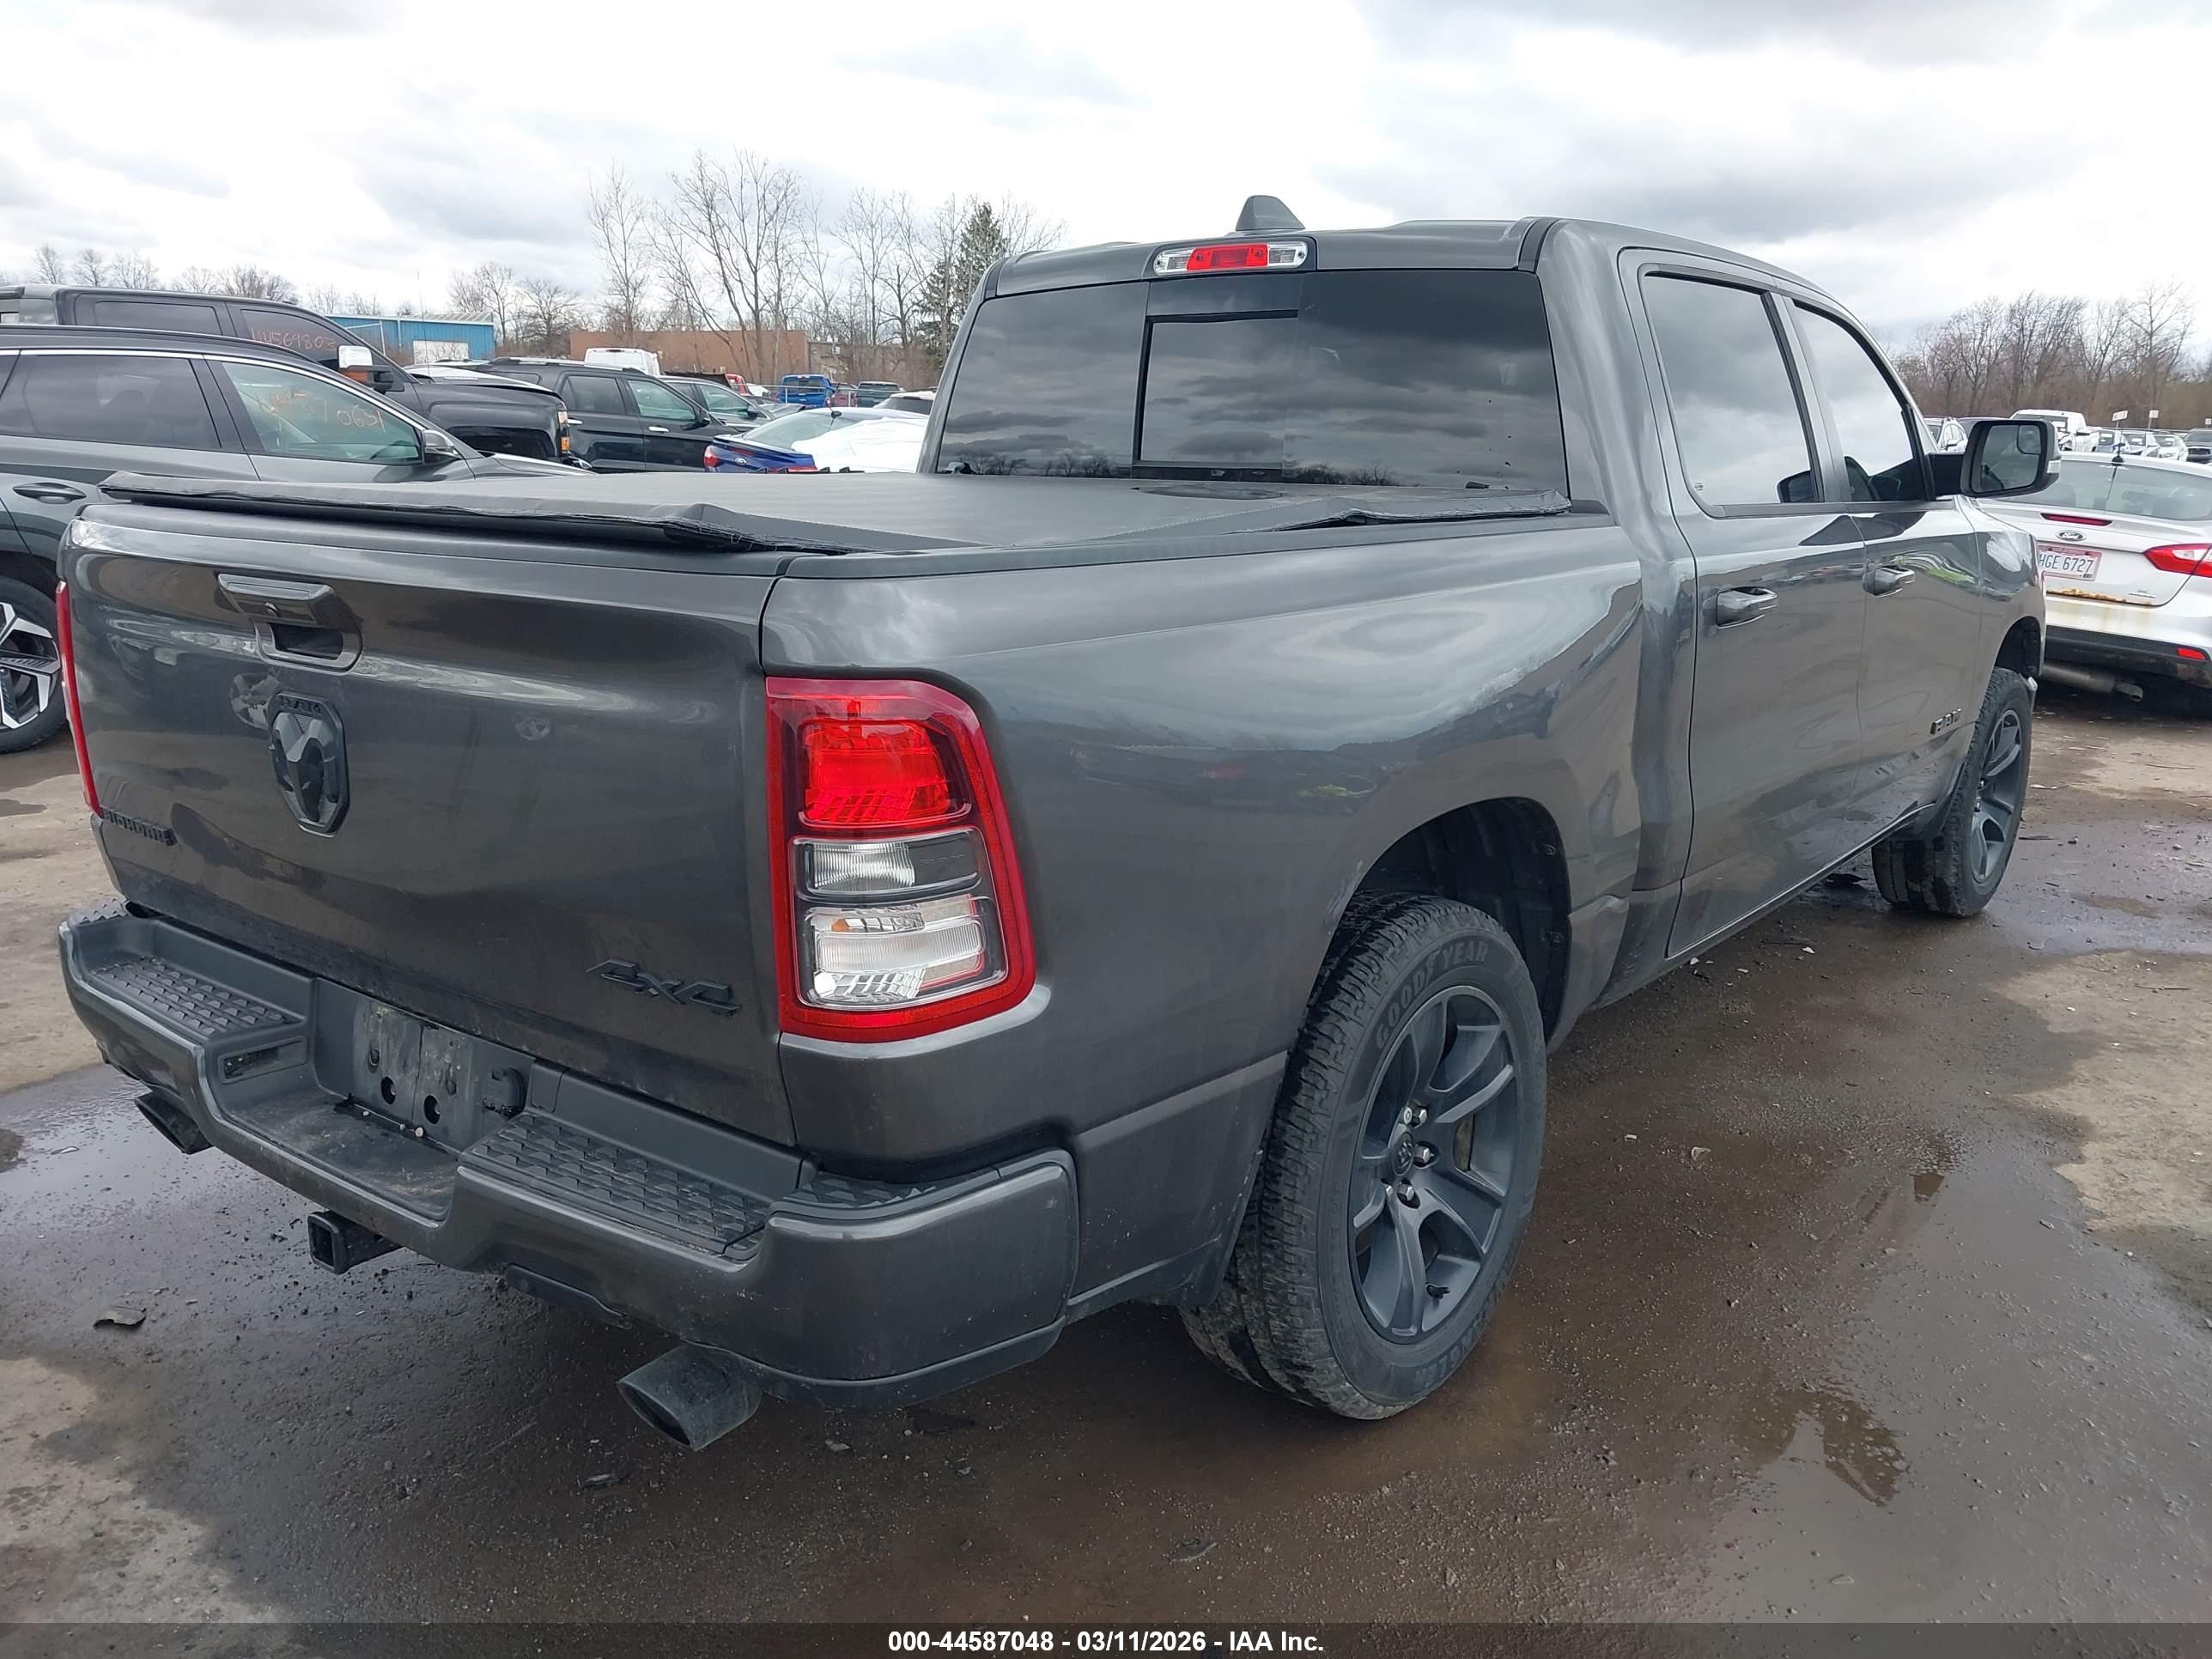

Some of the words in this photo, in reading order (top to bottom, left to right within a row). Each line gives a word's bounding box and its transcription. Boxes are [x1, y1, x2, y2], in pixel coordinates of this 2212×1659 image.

[2039, 553, 2061, 569] HGE
[2063, 556, 2094, 574] 6727
[282, 696, 321, 715] RAM
